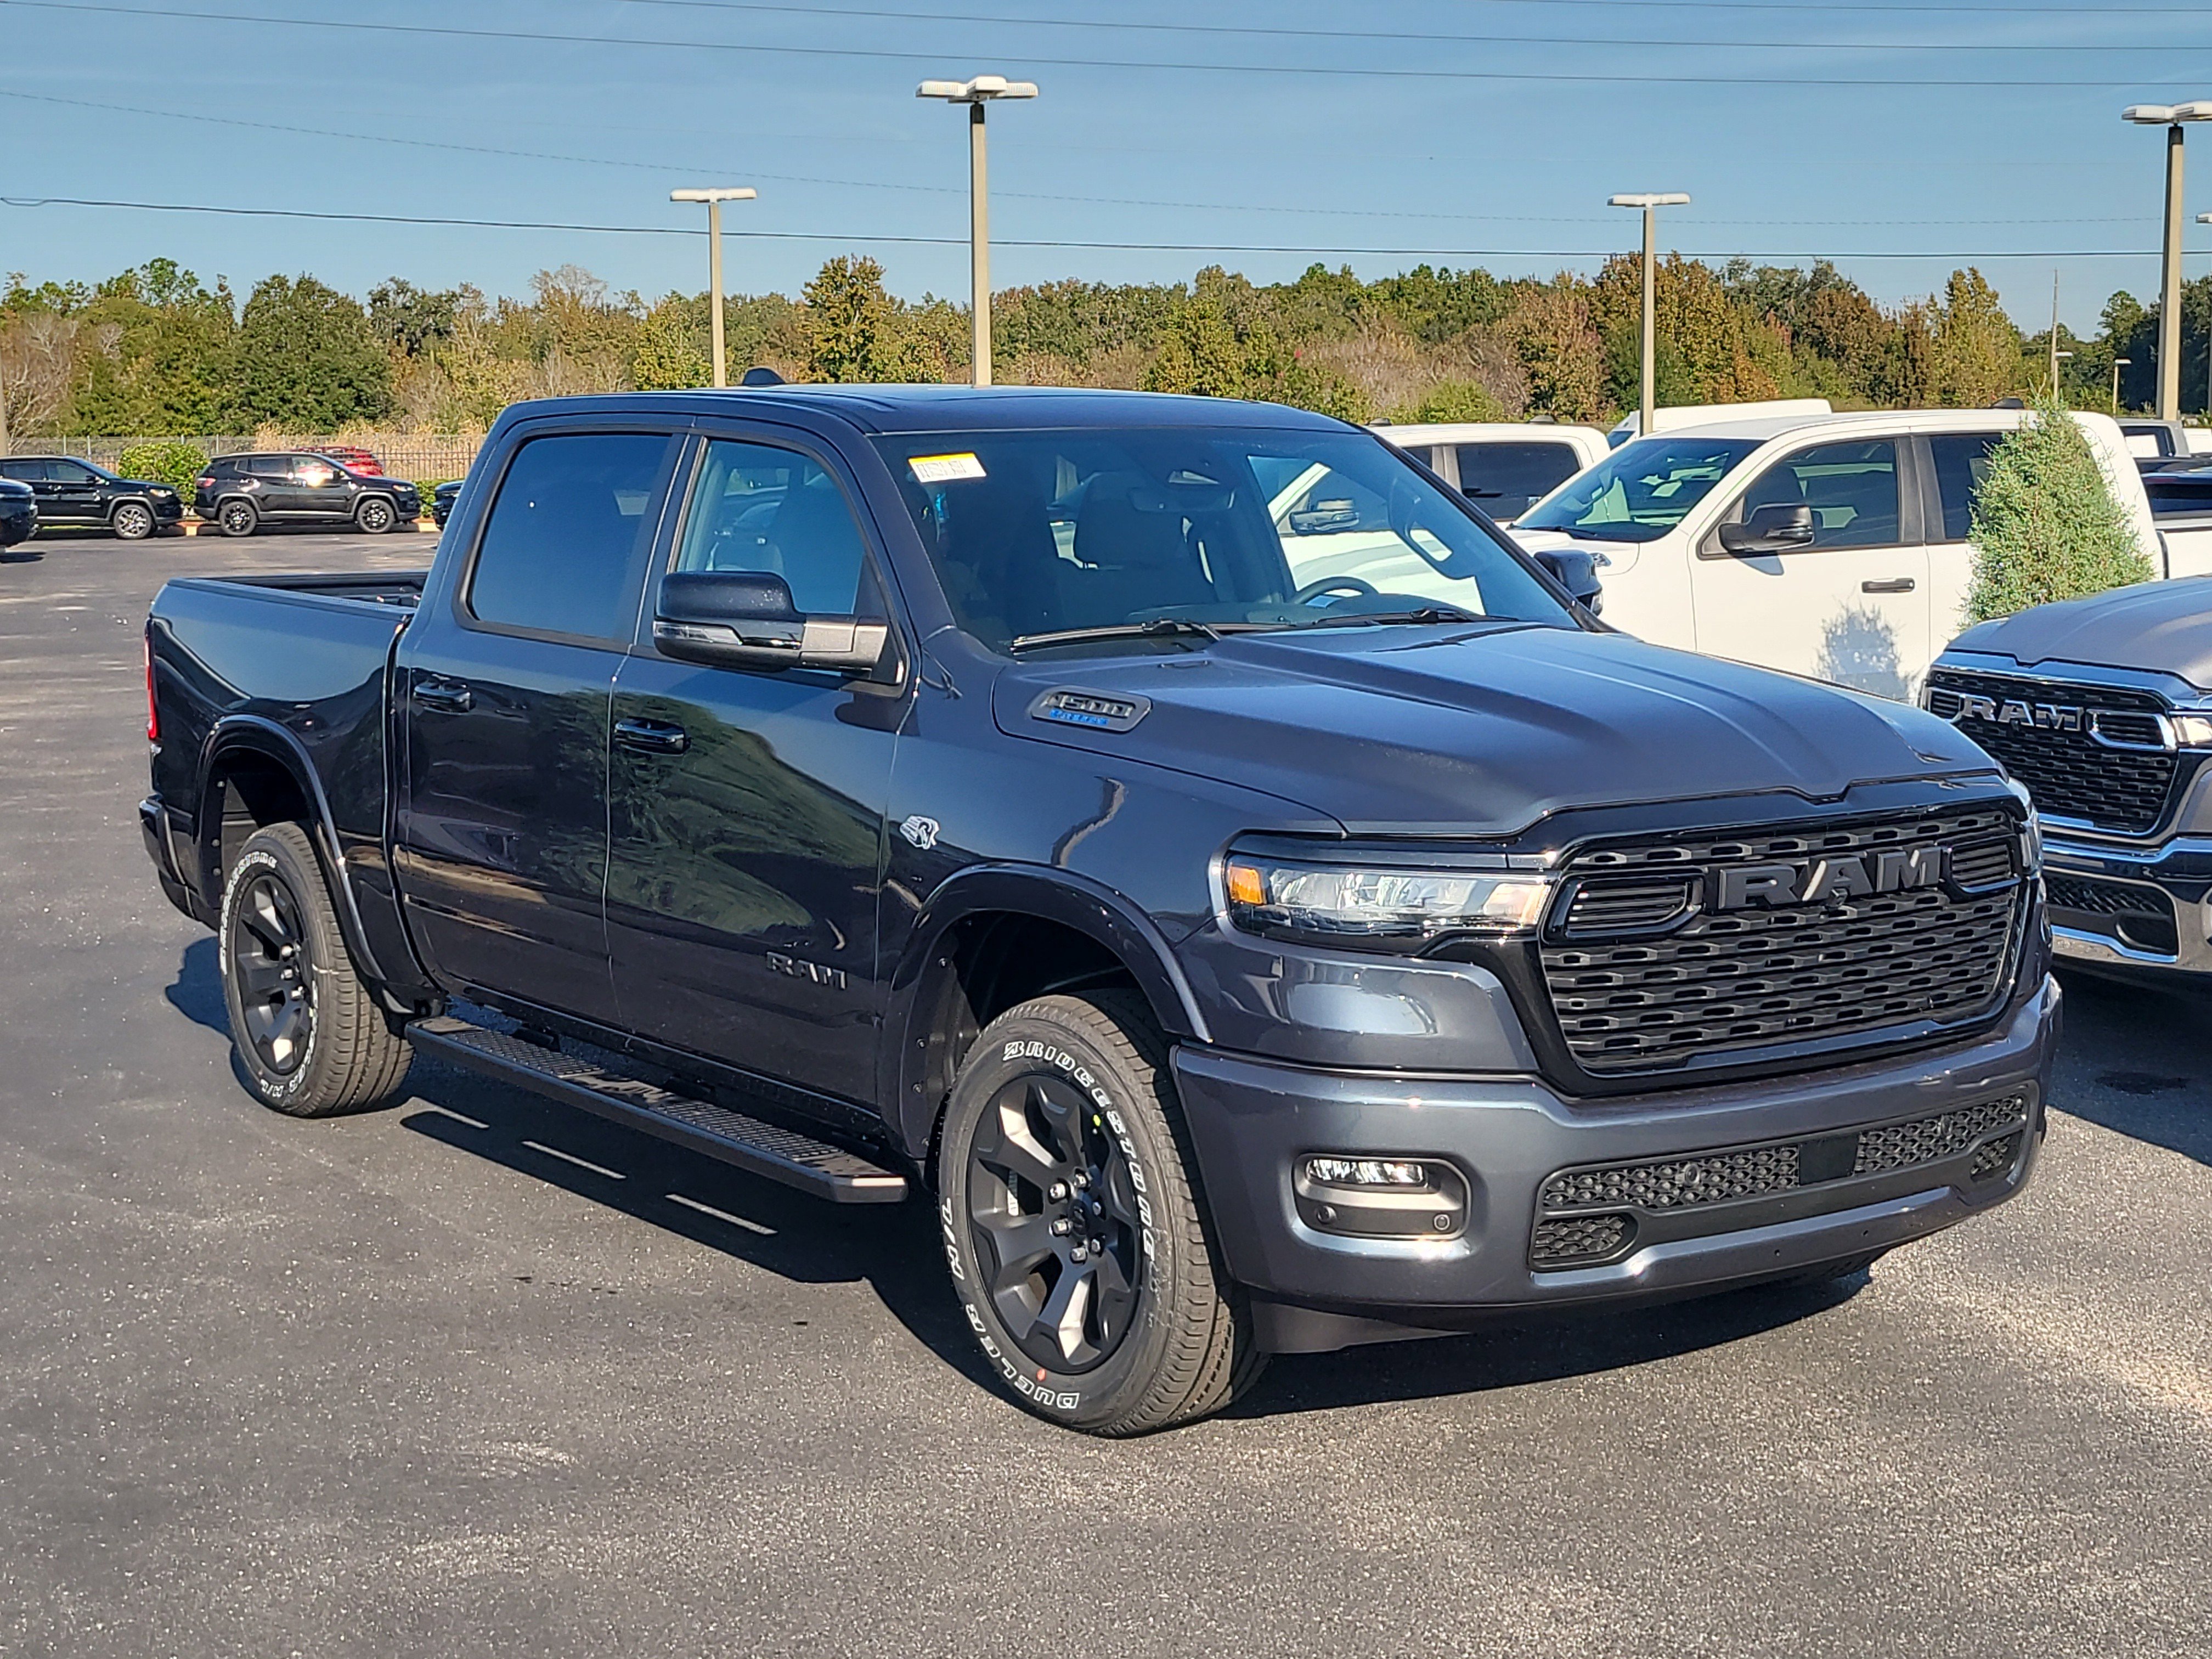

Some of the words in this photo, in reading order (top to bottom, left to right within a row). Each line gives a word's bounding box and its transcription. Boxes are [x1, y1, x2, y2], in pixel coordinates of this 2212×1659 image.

[1041, 693, 1134, 718] 1500
[1960, 693, 2085, 731] RAM
[1718, 847, 1942, 909] RAM
[766, 951, 847, 990] RAM
[1003, 1041, 1155, 1261] BRIDGESTONE
[966, 1304, 1080, 1410] DUELER
